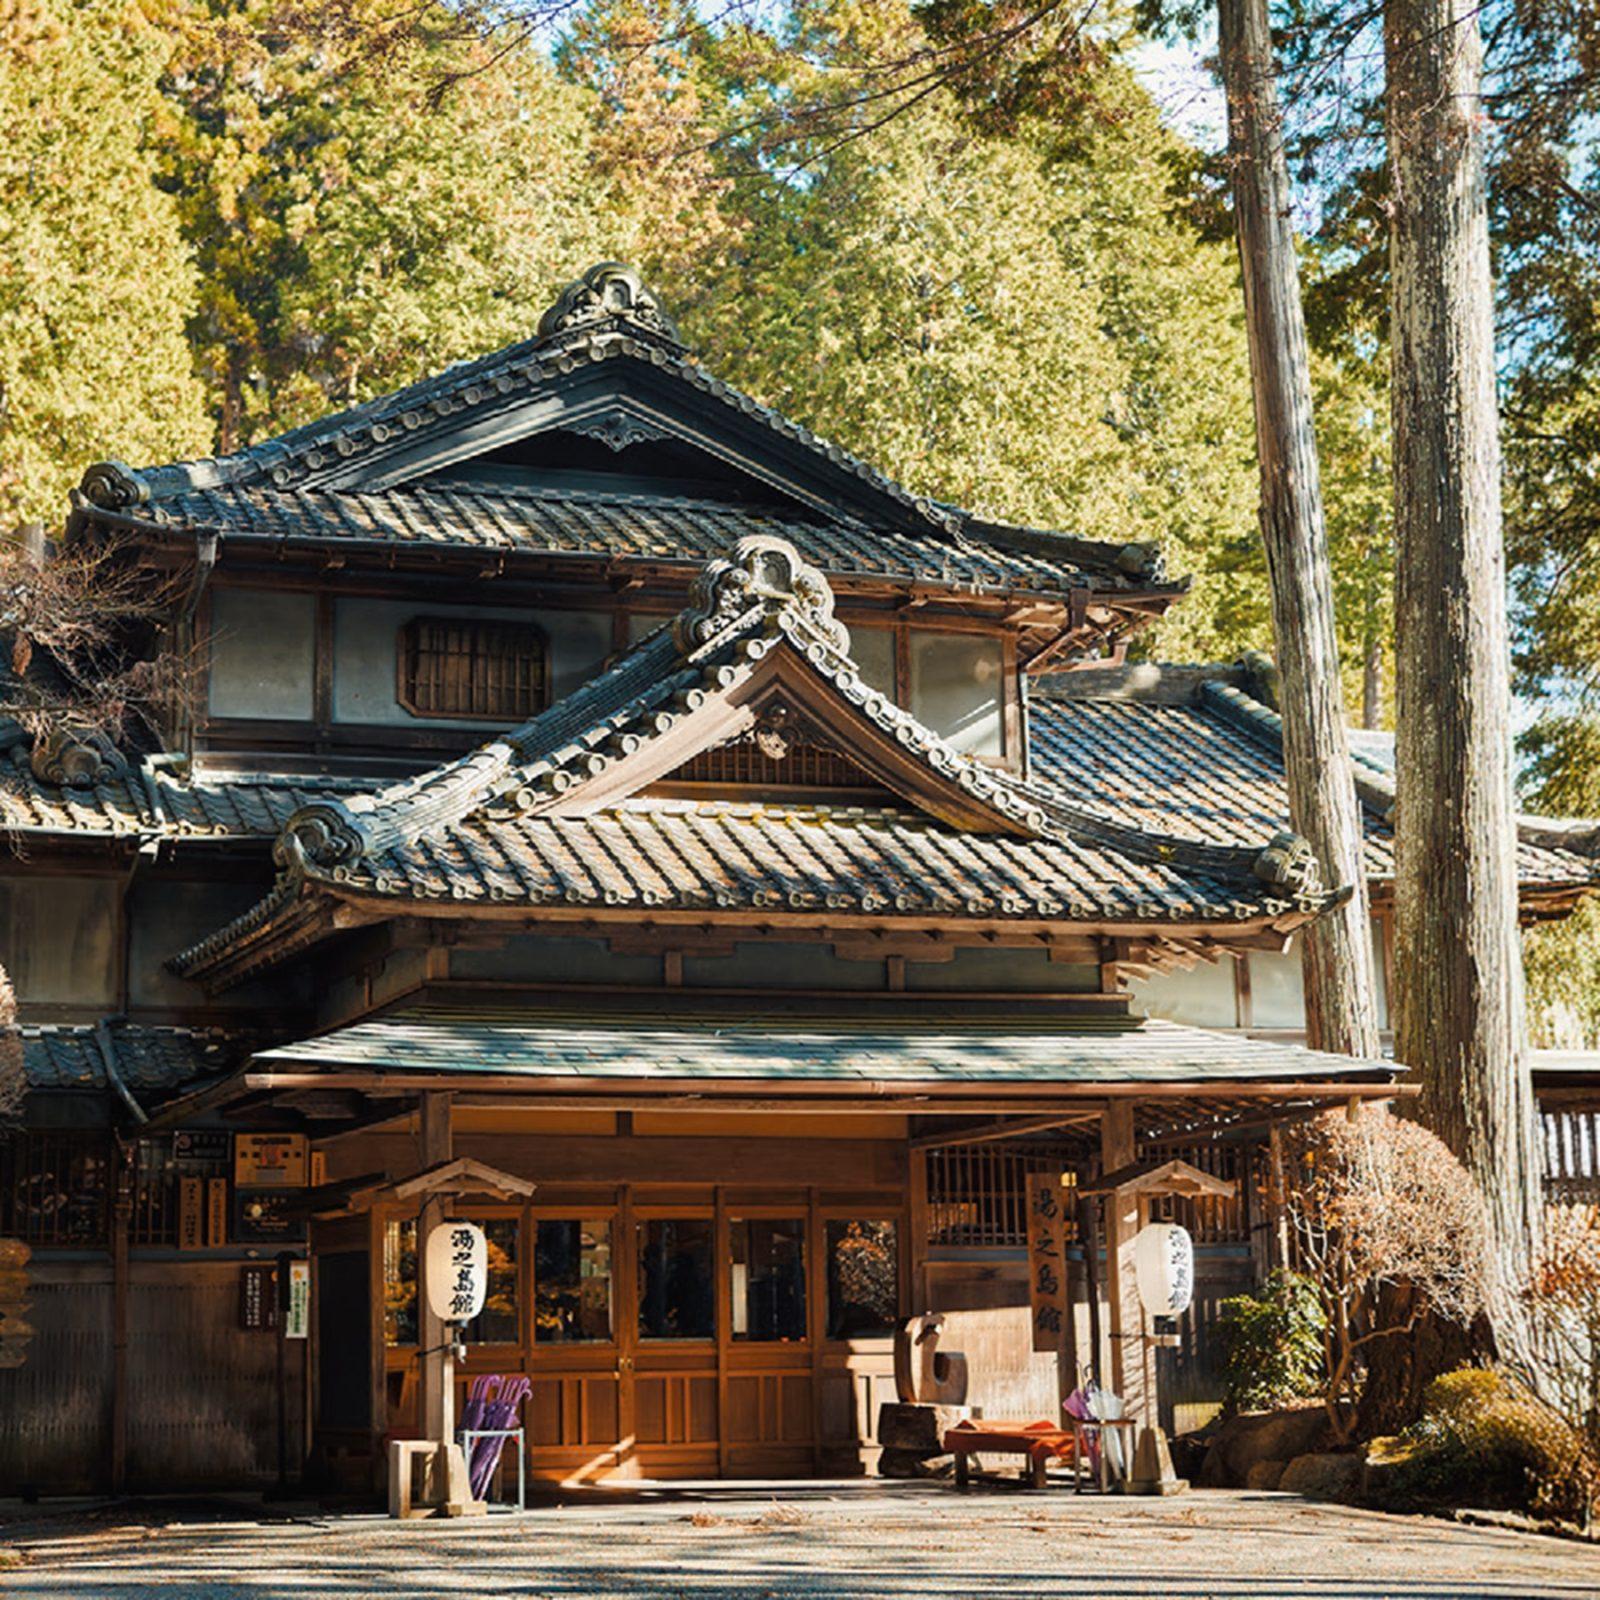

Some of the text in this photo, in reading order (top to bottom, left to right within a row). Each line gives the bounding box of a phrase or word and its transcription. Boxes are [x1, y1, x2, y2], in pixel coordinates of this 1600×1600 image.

[449, 1229, 475, 1315] 湯之島館
[1033, 1188, 1062, 1333] 湯之島館
